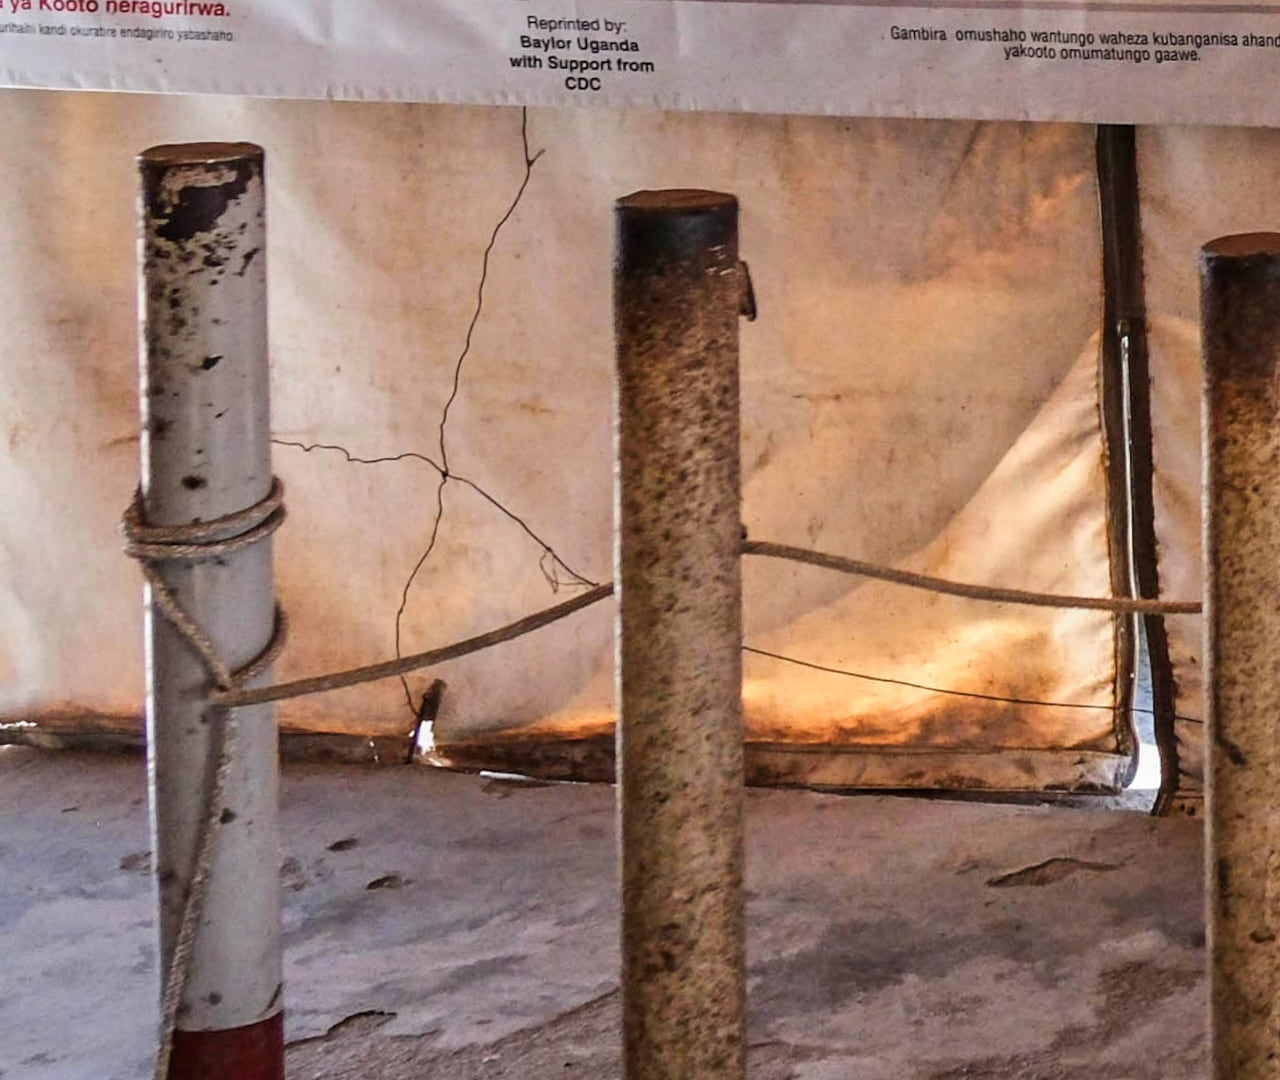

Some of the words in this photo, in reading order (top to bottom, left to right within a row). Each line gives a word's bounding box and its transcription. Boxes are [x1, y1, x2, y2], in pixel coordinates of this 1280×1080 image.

[526, 15, 605, 36] Reprinted
[607, 17, 626, 37] by:
[520, 36, 573, 56] Baylor
[576, 37, 640, 56] Uganda
[1002, 45, 1056, 62] yakooto
[1059, 46, 1150, 63] omumatungo
[1154, 50, 1200, 64] gaawe.
[509, 55, 541, 70] with
[547, 56, 613, 74] Support
[616, 57, 655, 72] from
[564, 76, 601, 91] CDC
